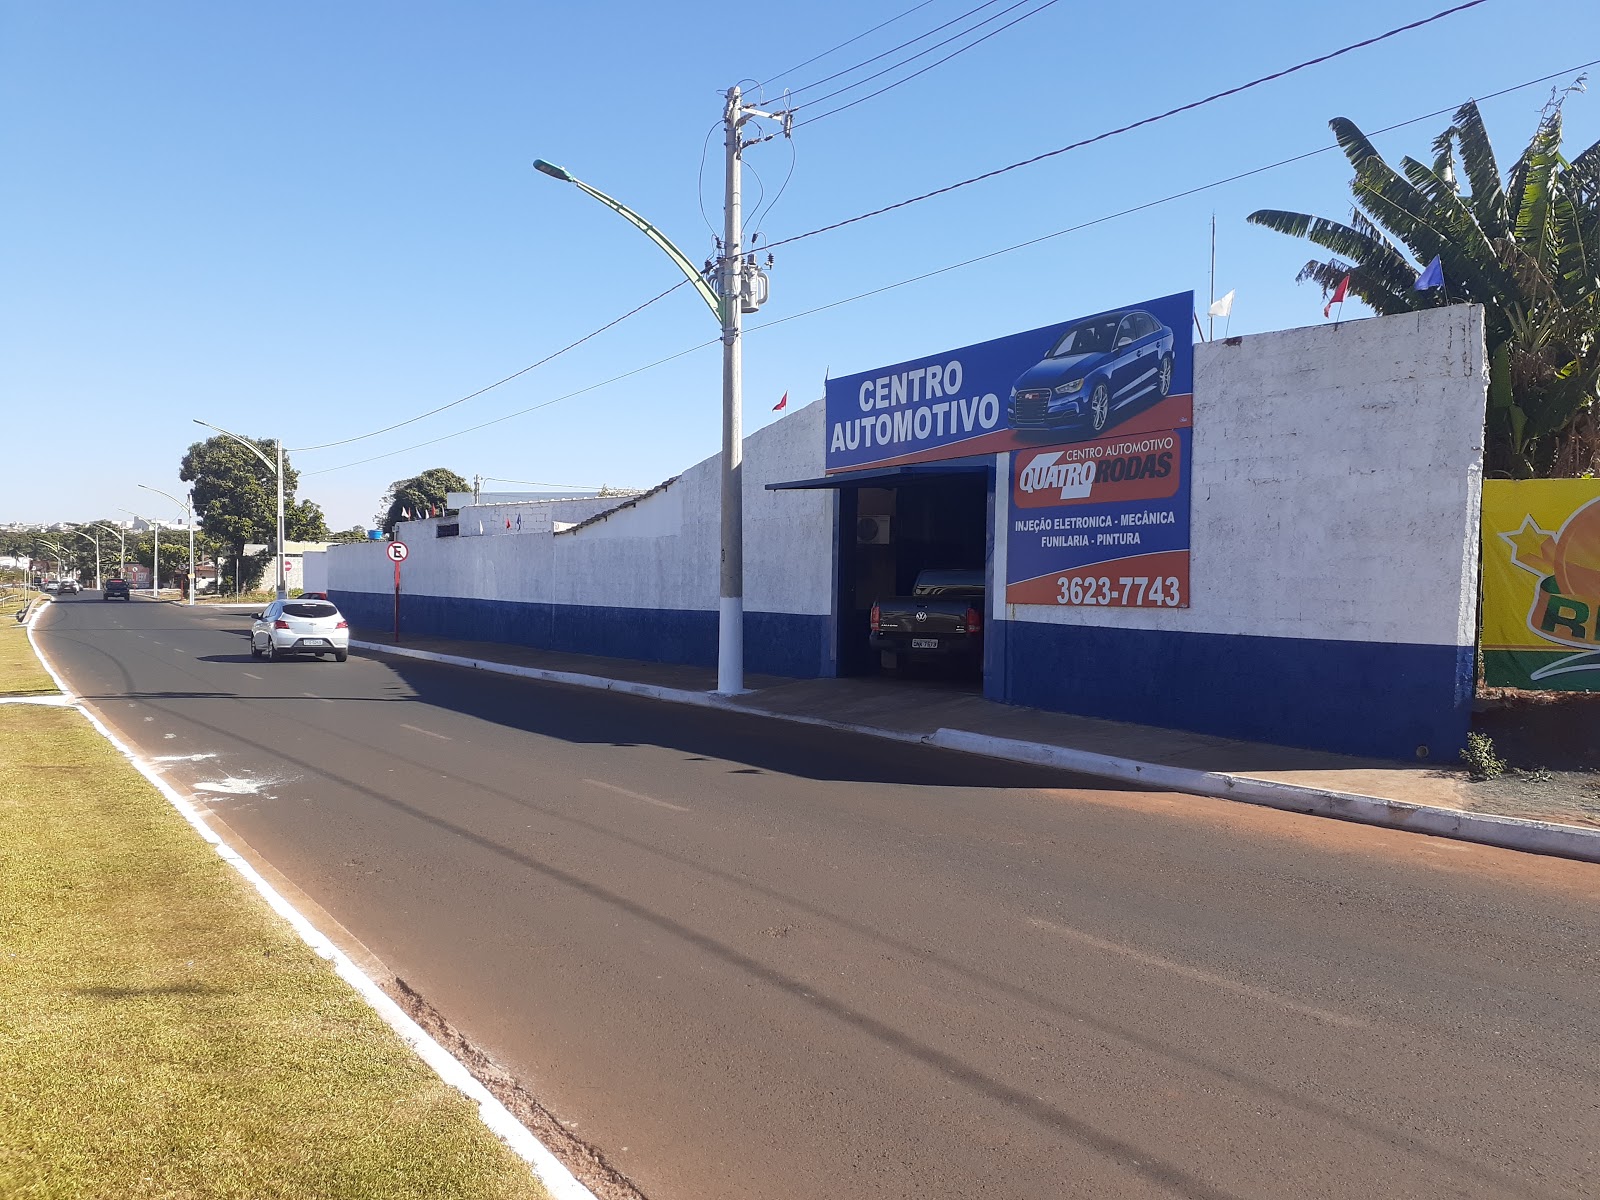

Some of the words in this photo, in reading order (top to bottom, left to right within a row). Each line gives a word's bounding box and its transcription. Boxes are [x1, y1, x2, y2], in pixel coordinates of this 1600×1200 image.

[859, 360, 963, 412] CENTRO
[830, 393, 1000, 453] AUTOMOTIVO
[1066, 446, 1103, 461] CENTRO
[1105, 437, 1174, 457] AUTOMOTIVO
[1019, 460, 1097, 494] QUATRO
[1095, 452, 1173, 484] RODAS
[1015, 517, 1052, 533] INJEÇÃO
[1054, 515, 1112, 530] ELETRONICA
[1120, 510, 1175, 526] MECÂNICA
[393, 545, 402, 558] E
[1041, 534, 1089, 547] FUNILARIA
[1097, 532, 1141, 546] PINTURA
[1056, 576, 1180, 607] 3623-7743
[1541, 594, 1600, 641] R
